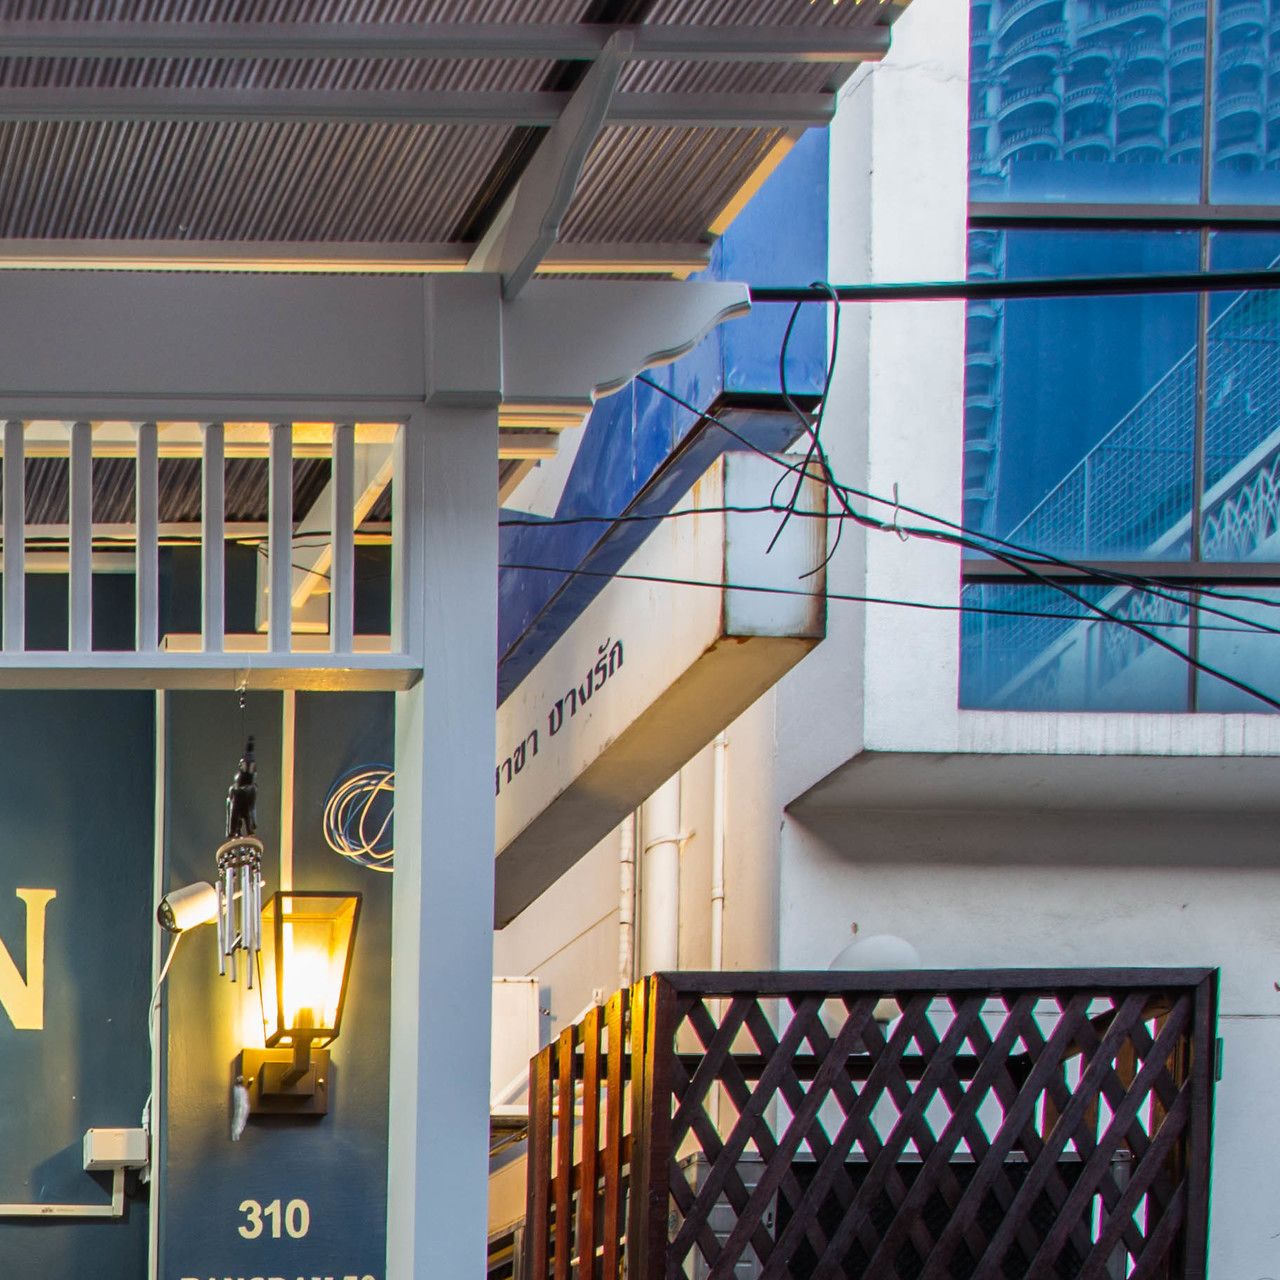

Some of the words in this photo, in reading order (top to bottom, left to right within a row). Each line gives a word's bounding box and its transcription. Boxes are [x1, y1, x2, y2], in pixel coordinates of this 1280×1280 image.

[548, 637, 624, 737] บางรัก
[237, 1198, 311, 1239] 310
